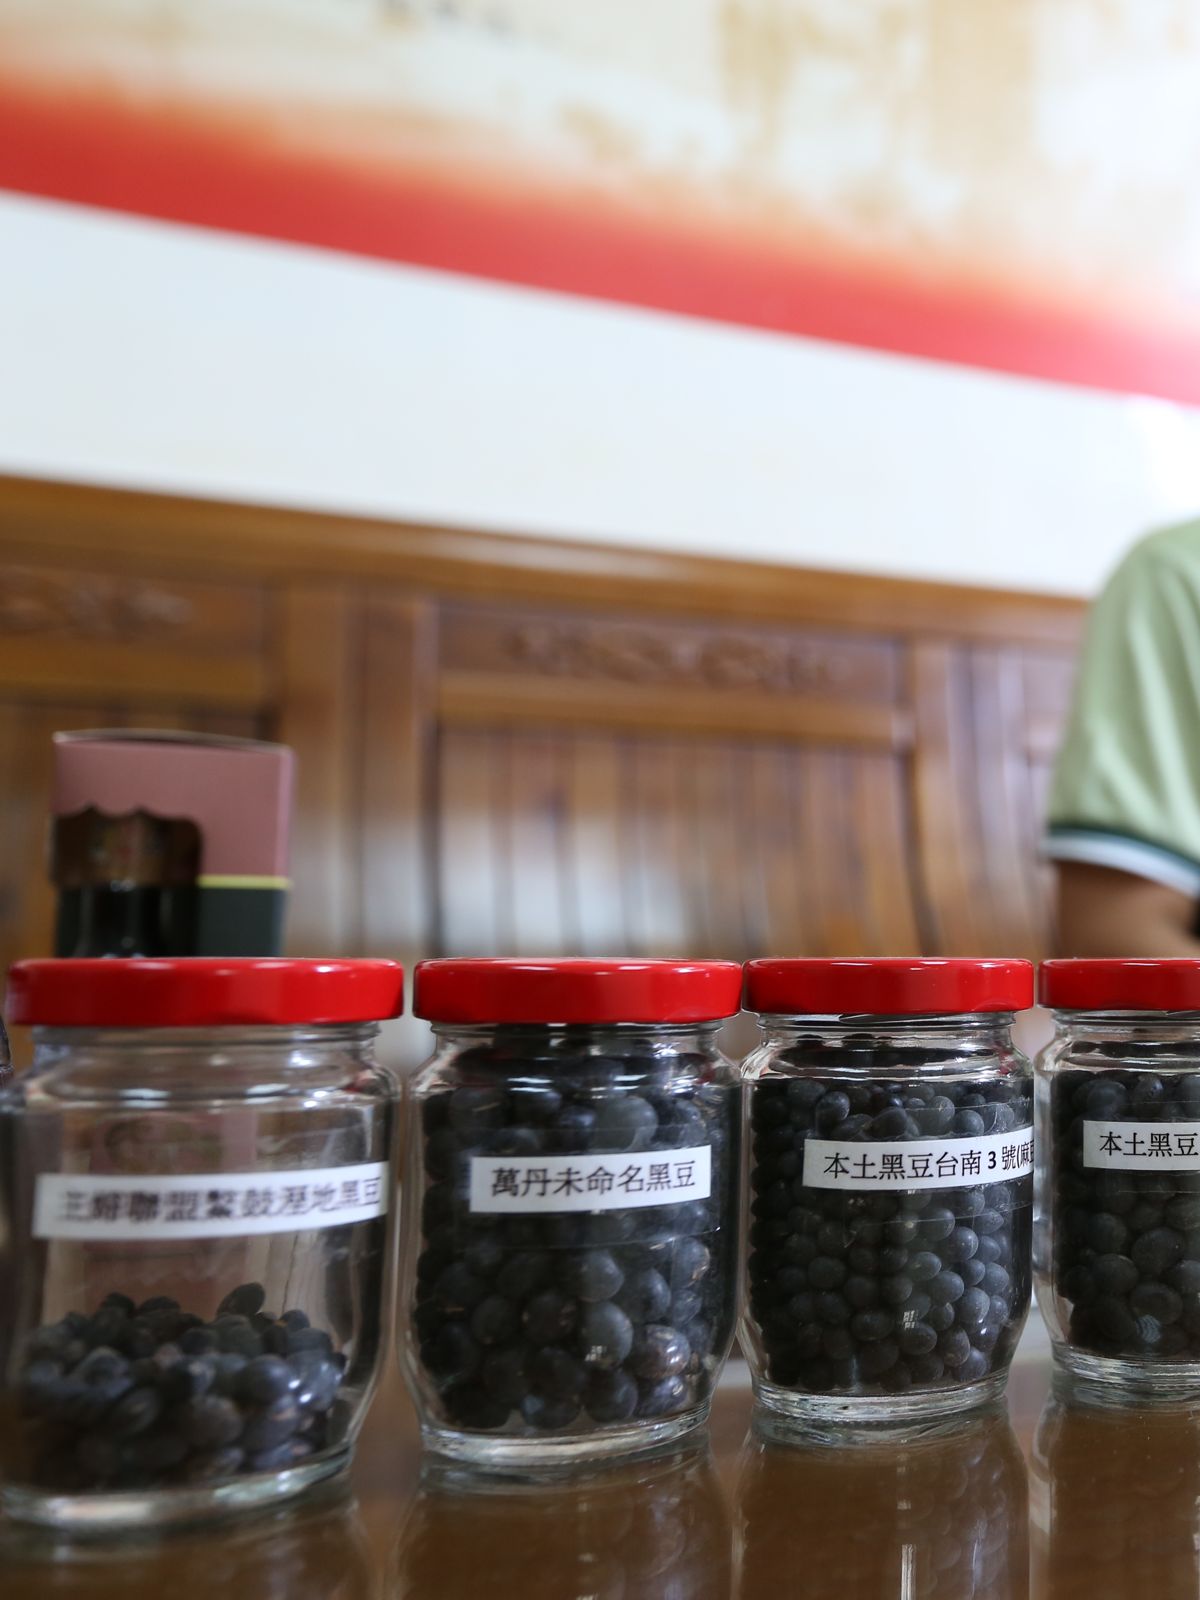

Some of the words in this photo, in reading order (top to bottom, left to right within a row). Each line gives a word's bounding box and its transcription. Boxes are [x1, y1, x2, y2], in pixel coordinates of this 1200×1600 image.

[491, 1159, 697, 1198] 萬丹未命名黑豆
[823, 1149, 982, 1181] 本土黑豆台南
[987, 1151, 997, 1170] 3
